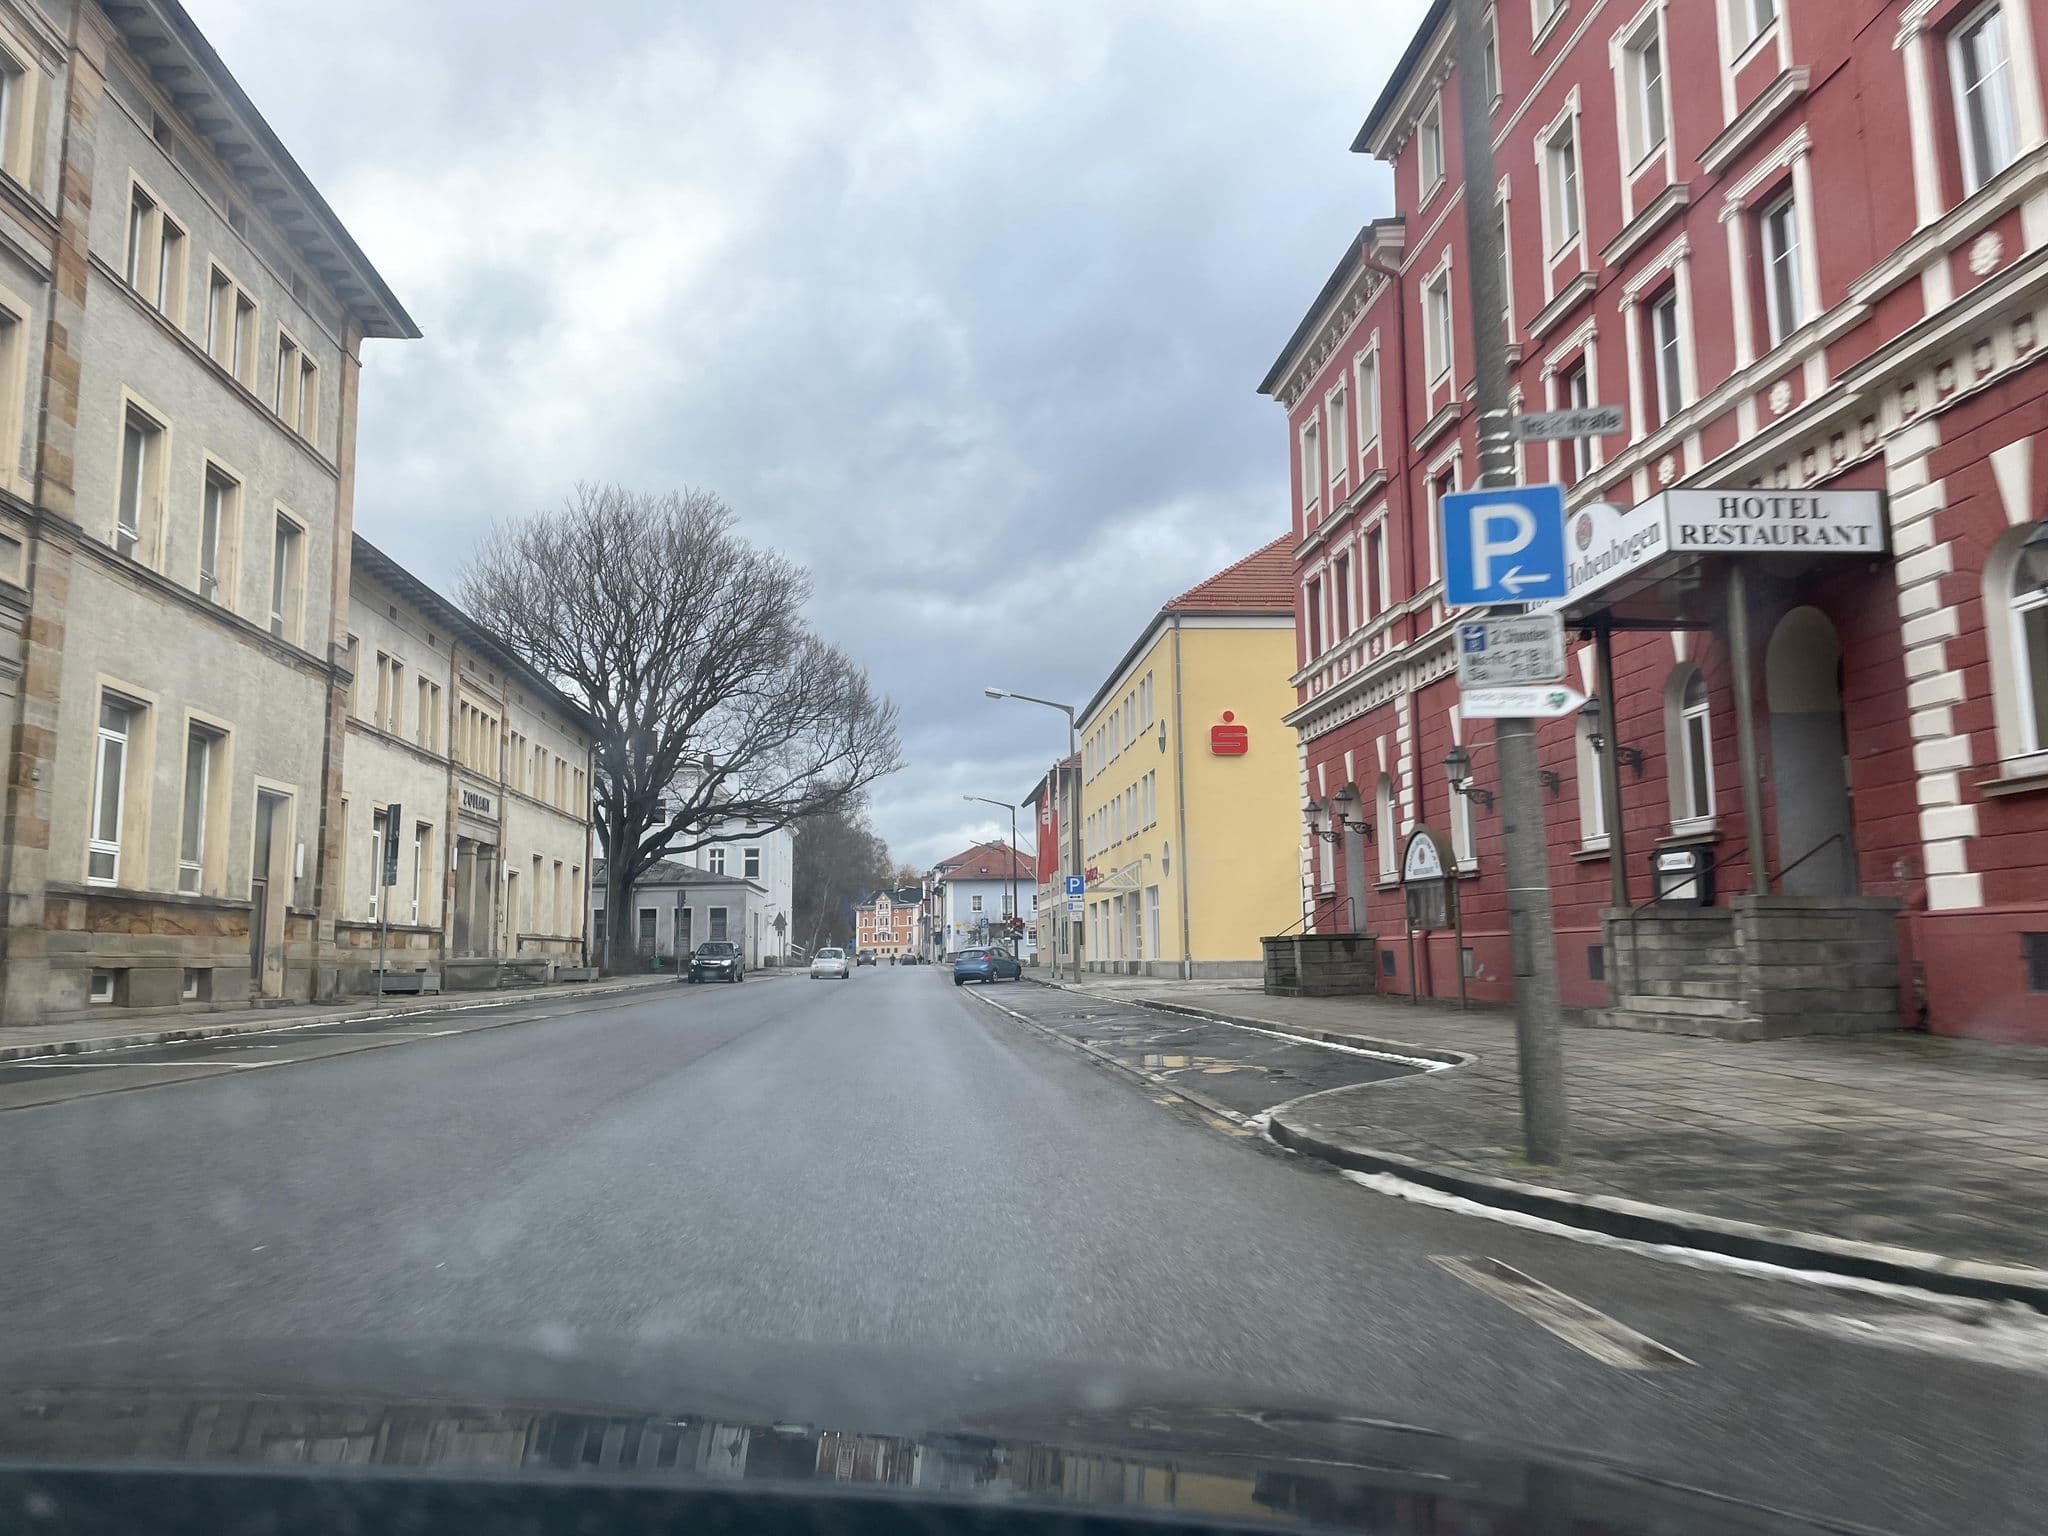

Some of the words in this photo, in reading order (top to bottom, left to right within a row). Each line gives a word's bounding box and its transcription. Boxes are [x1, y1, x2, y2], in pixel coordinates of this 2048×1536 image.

[1718, 497, 1830, 520] HOTEL
[1679, 524, 1873, 546] RESTAURANT
[1470, 503, 1537, 590] P
[1070, 877, 1080, 893] P
